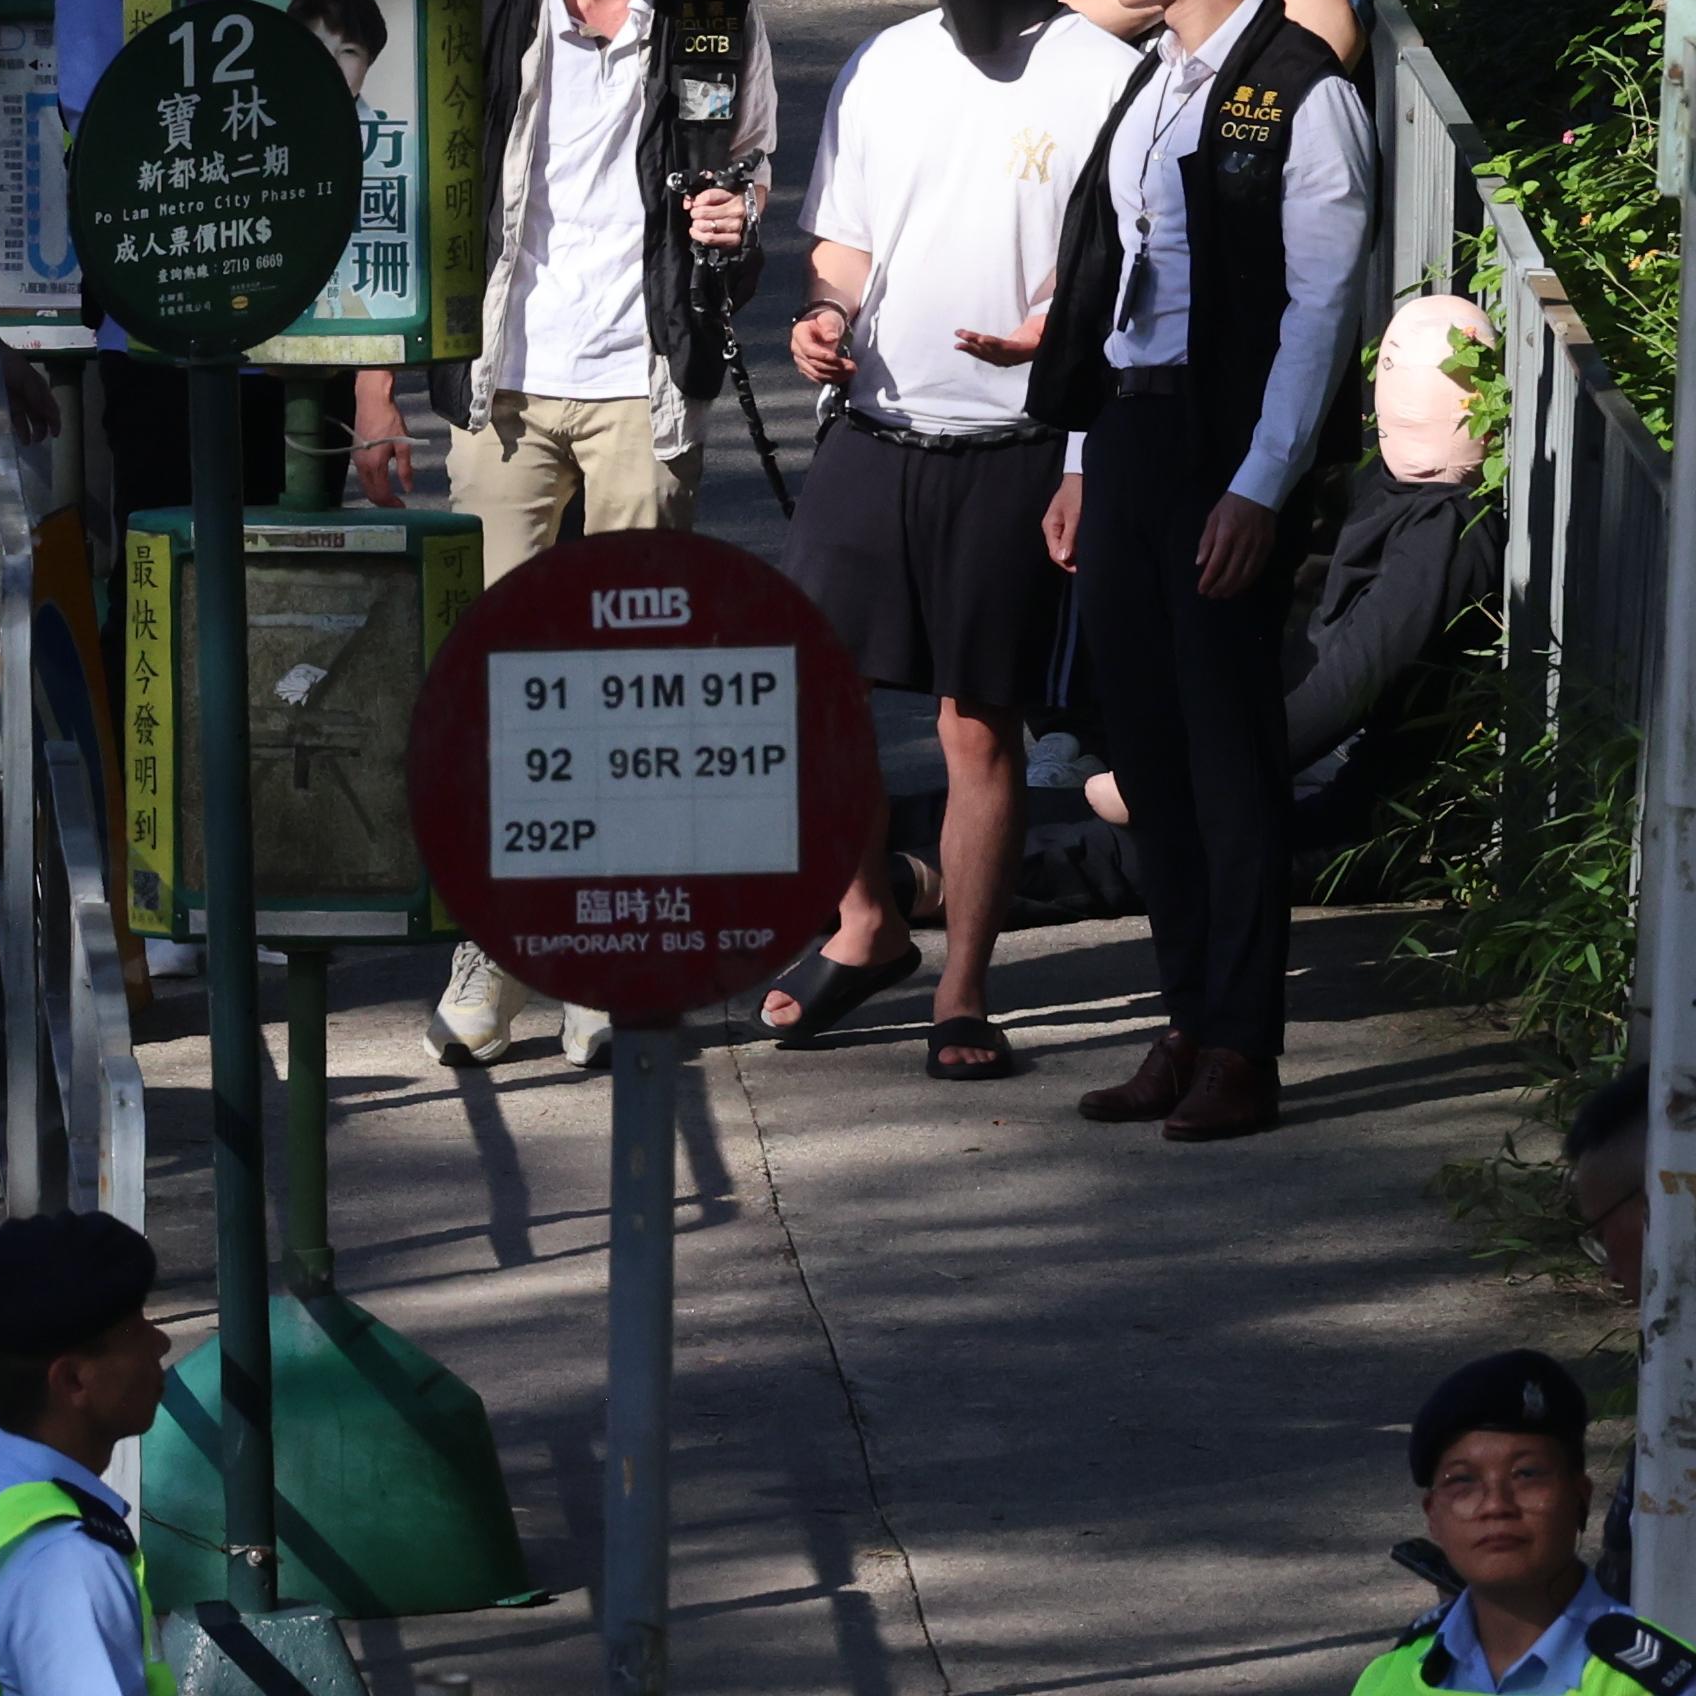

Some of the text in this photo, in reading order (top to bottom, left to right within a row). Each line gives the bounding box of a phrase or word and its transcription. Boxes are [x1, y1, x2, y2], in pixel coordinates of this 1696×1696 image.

[169, 14, 255, 87] 12
[685, 35, 730, 53] OCTB
[157, 85, 277, 154] 寶林
[1220, 101, 1283, 122] POLICE
[1221, 121, 1270, 142] OCTB
[137, 144, 289, 193] 新都城二期
[95, 181, 333, 224] Po Lam Metro City Phase II
[351, 109, 411, 300] 方國珊
[223, 257, 250, 276] 2719
[592, 587, 692, 629] KMB
[132, 545, 160, 850] 最快今發明到
[524, 673, 777, 710] 91 91M 91P
[526, 745, 786, 782] 92 96R 291P
[505, 819, 596, 852] 292P
[576, 888, 691, 924] 臨時站
[515, 928, 774, 956] TEMPORARY BUS STOP
